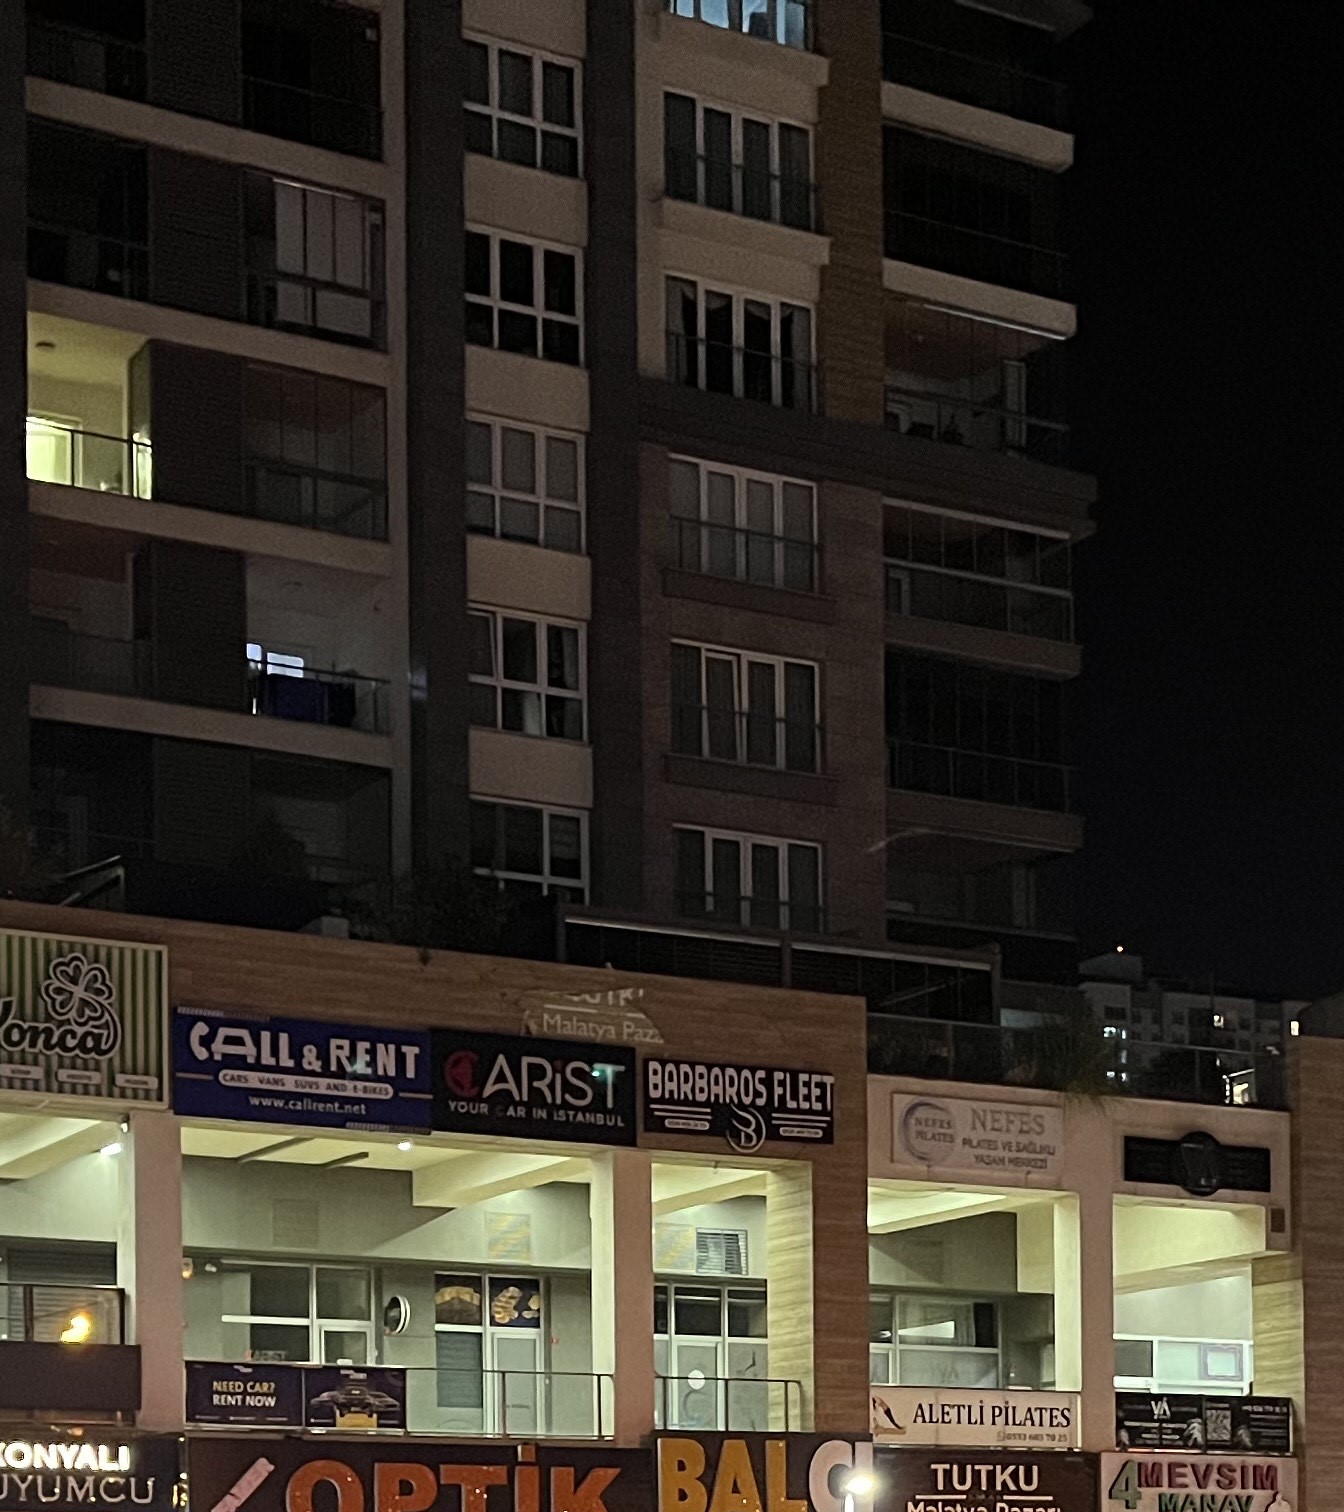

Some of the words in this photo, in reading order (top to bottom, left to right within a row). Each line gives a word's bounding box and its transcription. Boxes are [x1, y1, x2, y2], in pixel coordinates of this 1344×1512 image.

[542, 1013, 616, 1042] Malatya
[302, 1044, 323, 1073] &
[329, 1037, 421, 1079] RENT
[222, 1072, 250, 1084] CARS
[258, 1076, 286, 1088] VANS
[294, 1079, 321, 1091] SUVS
[325, 1082, 348, 1094] AND
[648, 1060, 767, 1107] BARBAROS
[773, 1070, 836, 1112] FLEET
[248, 1094, 367, 1116] www.callrent.net
[448, 1099, 489, 1116] YOUR
[532, 1107, 548, 1121] IN
[914, 1117, 953, 1130] NEFES
[970, 1108, 1045, 1136] NEFES
[212, 1380, 244, 1393] NEED
[247, 1381, 276, 1394] CAR?
[212, 1394, 244, 1407] RENT
[245, 1395, 277, 1408] NOW
[912, 1399, 985, 1425] ALETLİ
[991, 1400, 1072, 1428] PİLATES
[930, 1463, 1040, 1492] TUTKU
[1109, 1459, 1143, 1510] 4
